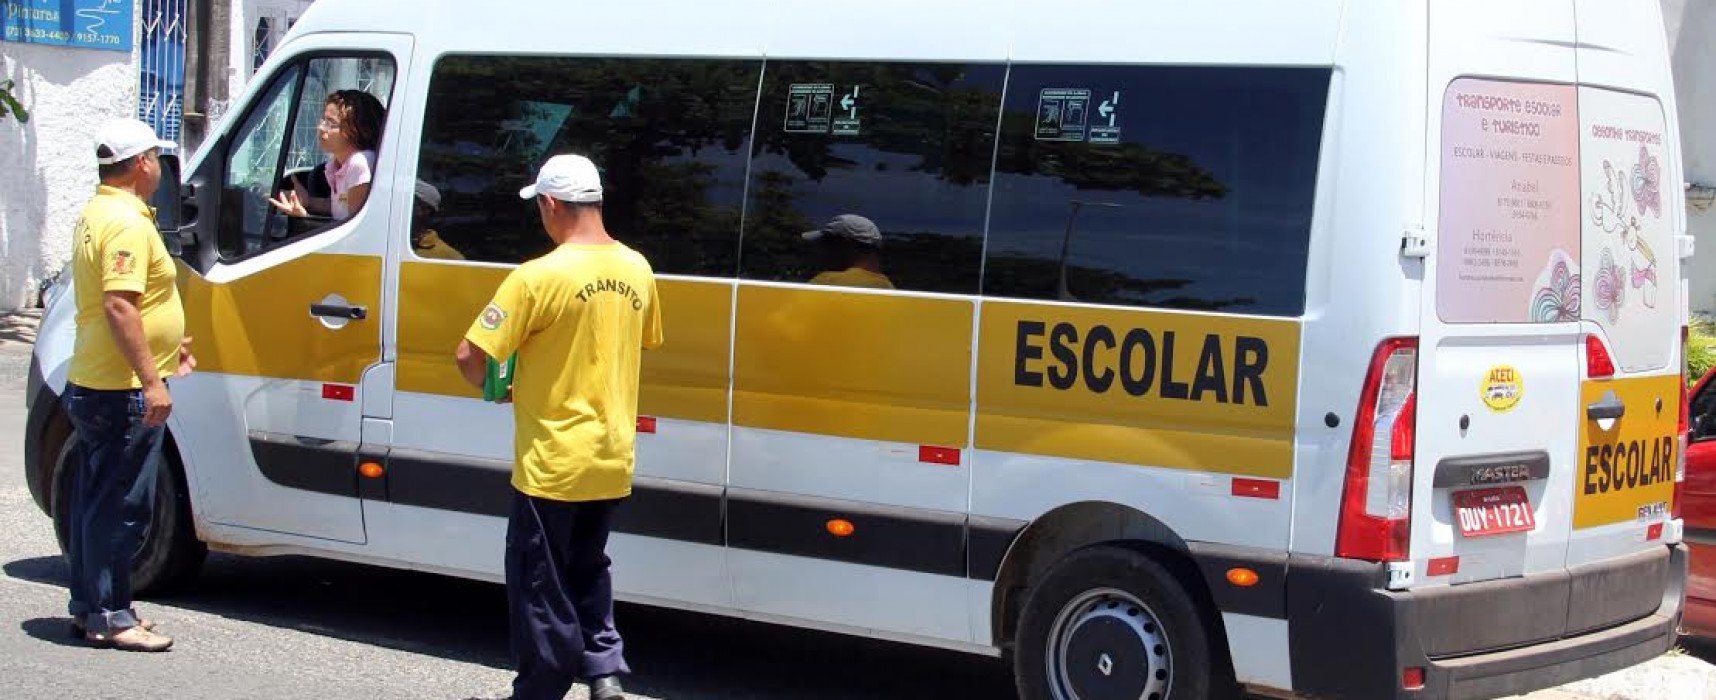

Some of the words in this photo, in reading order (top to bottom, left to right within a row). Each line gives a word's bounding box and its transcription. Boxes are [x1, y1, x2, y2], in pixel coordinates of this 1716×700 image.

[1014, 320, 1268, 407] ESCOLAR
[1470, 464, 1529, 484] MASTER
[1583, 436, 1672, 495] ESCOLAR
